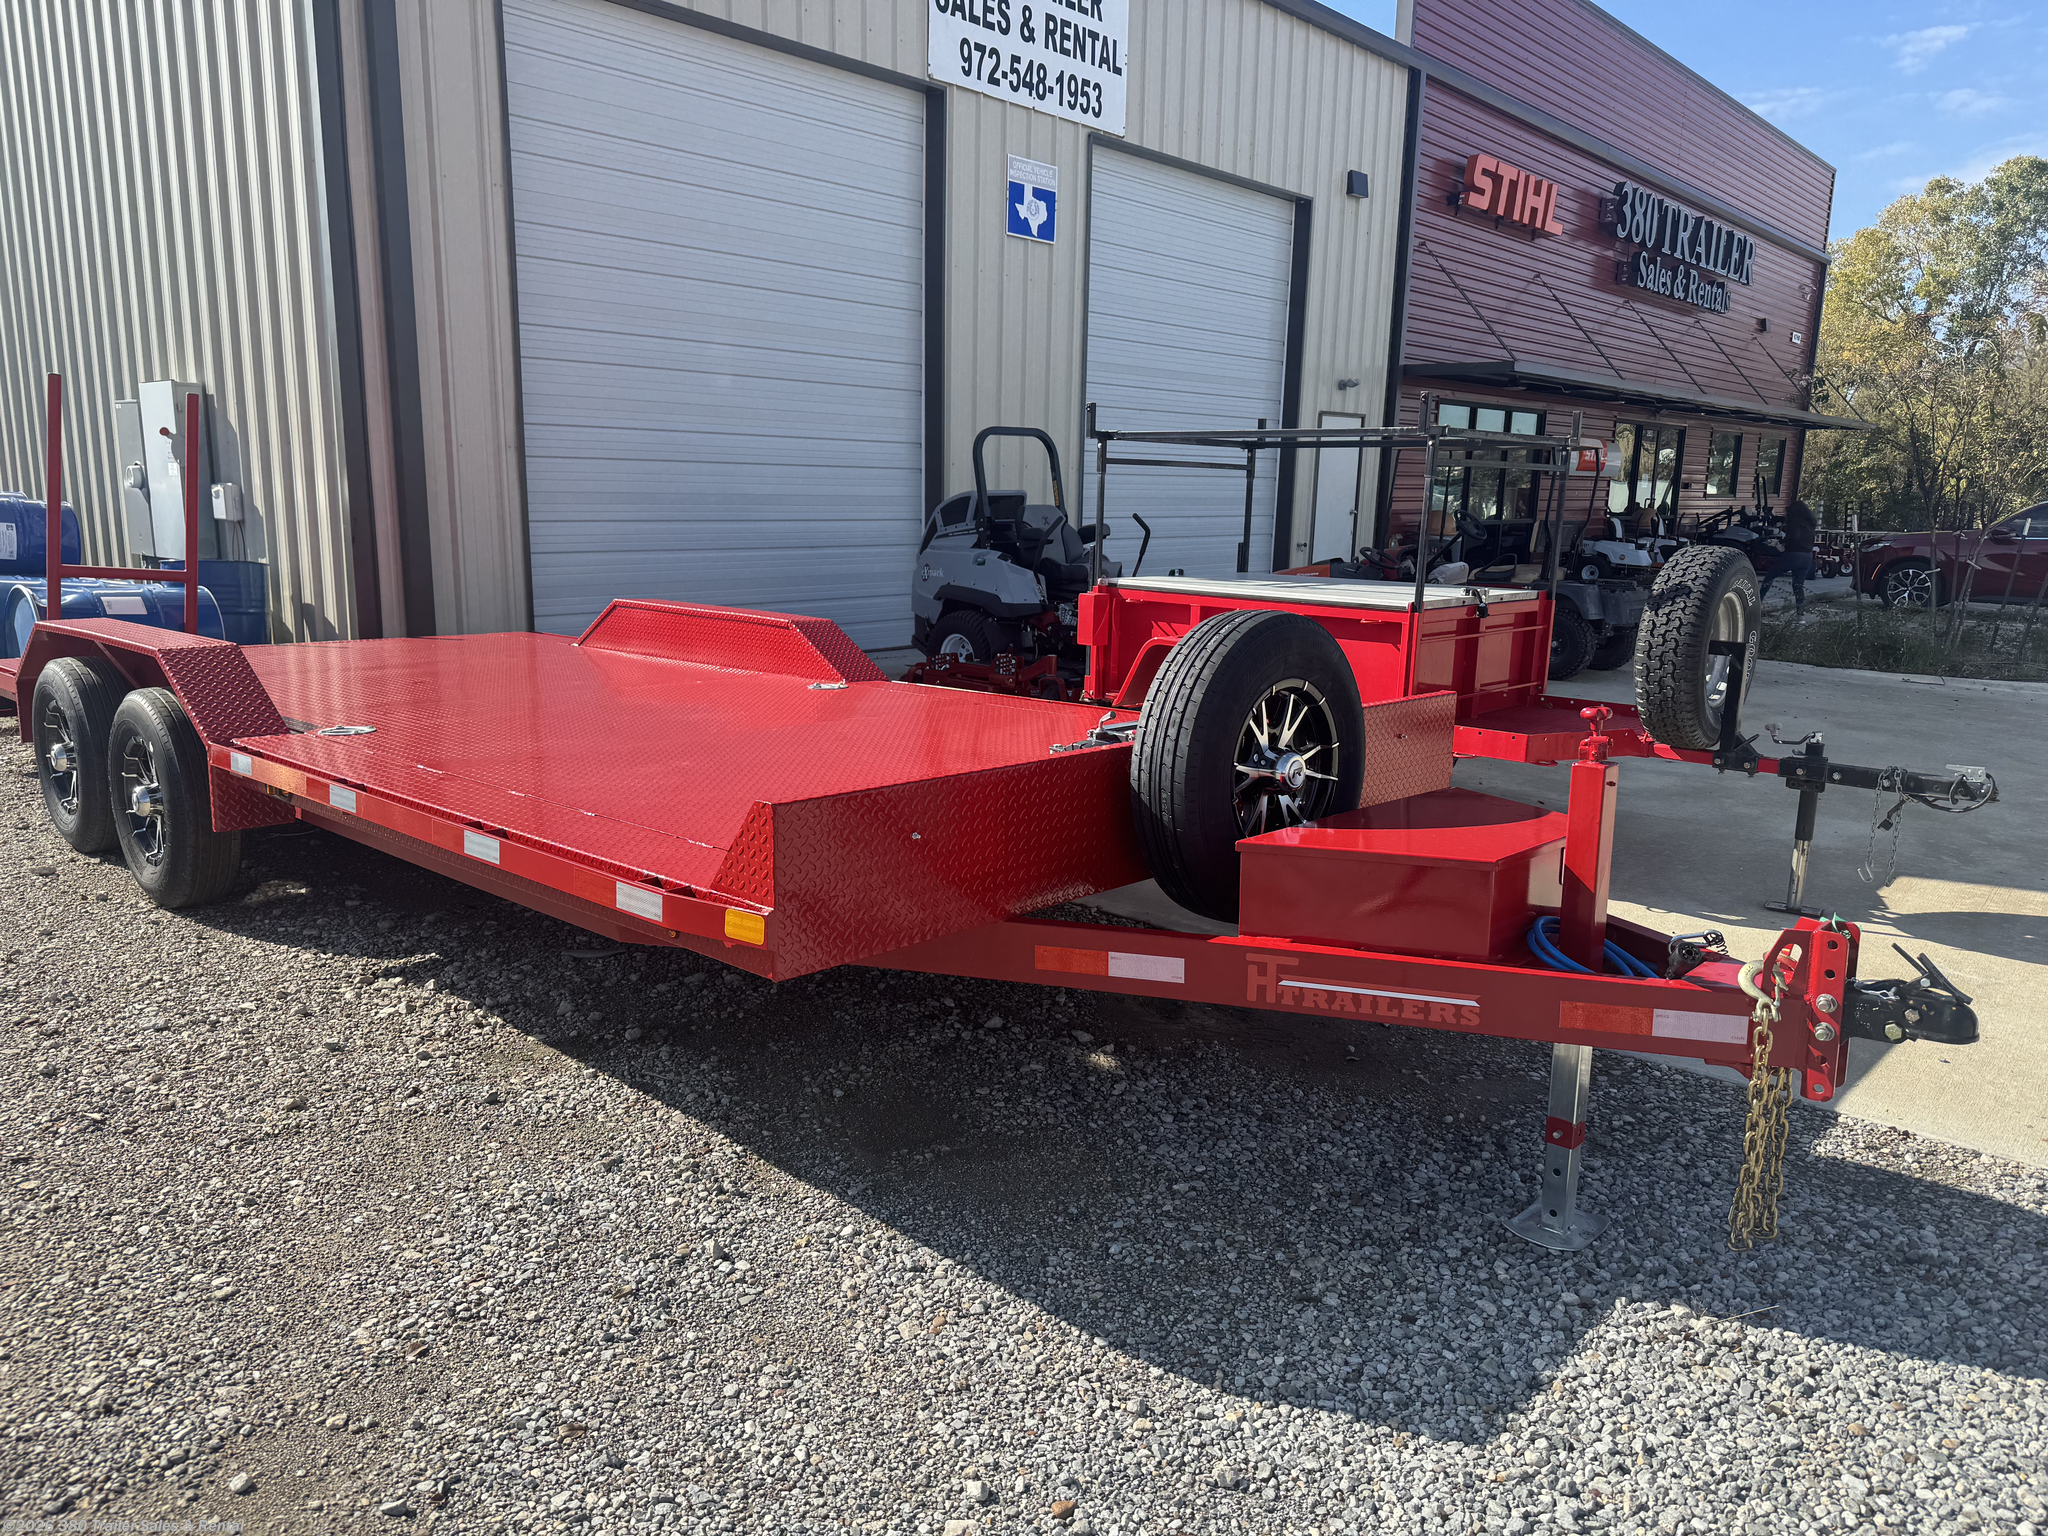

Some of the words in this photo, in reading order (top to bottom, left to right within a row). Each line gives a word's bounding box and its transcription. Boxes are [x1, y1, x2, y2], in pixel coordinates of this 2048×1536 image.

[1020, 4, 1036, 45] &
[1044, 12, 1122, 77] RENTAL
[959, 37, 1103, 119] 972-548-1953
[1010, 169, 1037, 182] INSPECTION
[1037, 175, 1056, 186] STATION
[1013, 160, 1033, 173] OFFICIAL
[1033, 166, 1053, 178] VEHICLE
[1465, 153, 1564, 236] STIHL
[1615, 180, 1659, 248] 380
[1660, 198, 1757, 286] TRAILER
[1637, 251, 1672, 298] Sales
[1673, 264, 1687, 300] &
[1277, 987, 1481, 1027] TRAILERS
